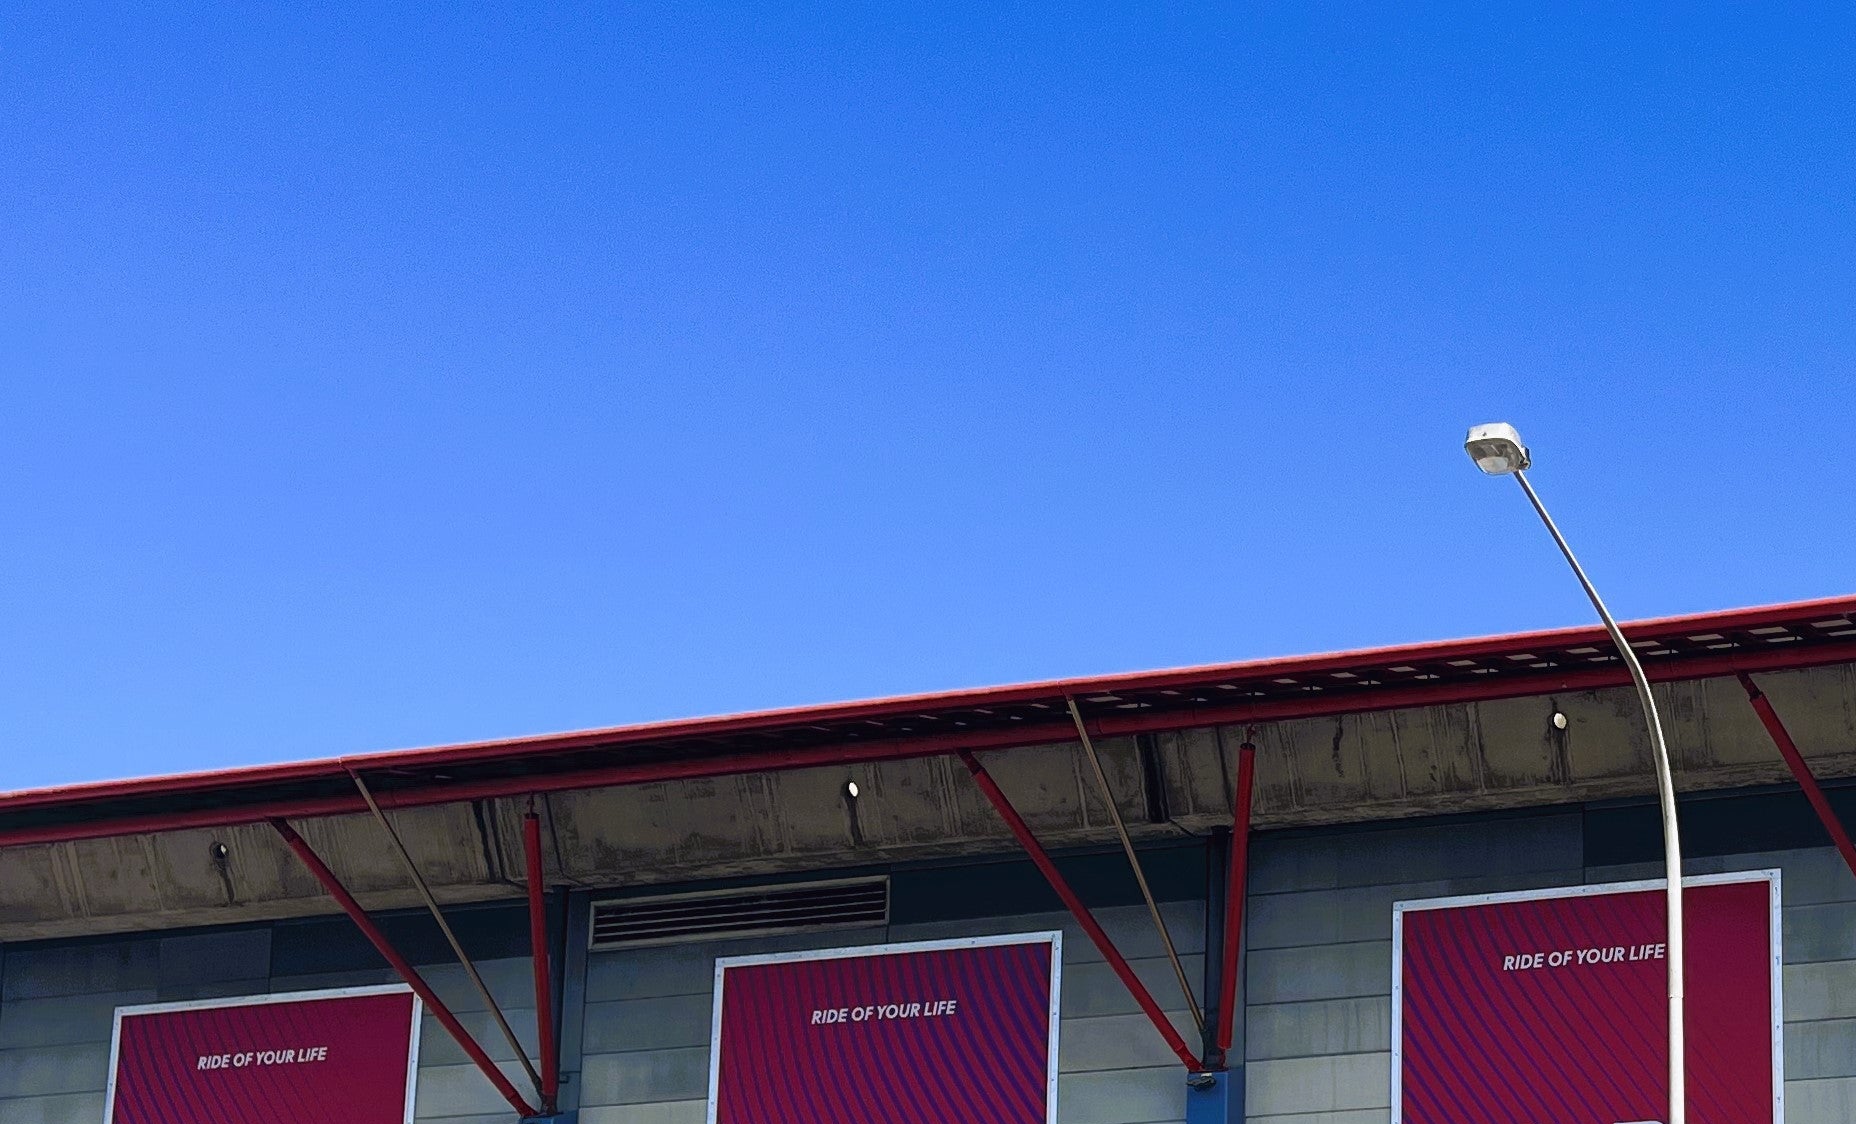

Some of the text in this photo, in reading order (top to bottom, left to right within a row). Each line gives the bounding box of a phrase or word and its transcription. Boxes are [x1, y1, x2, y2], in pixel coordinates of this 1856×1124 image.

[1503, 943, 1666, 971] RIDE OF YOUR LIFE
[811, 1000, 957, 1025] RIDE OF YOUR LIFE
[197, 1046, 328, 1070] RIDE OF YOUR LIFE
